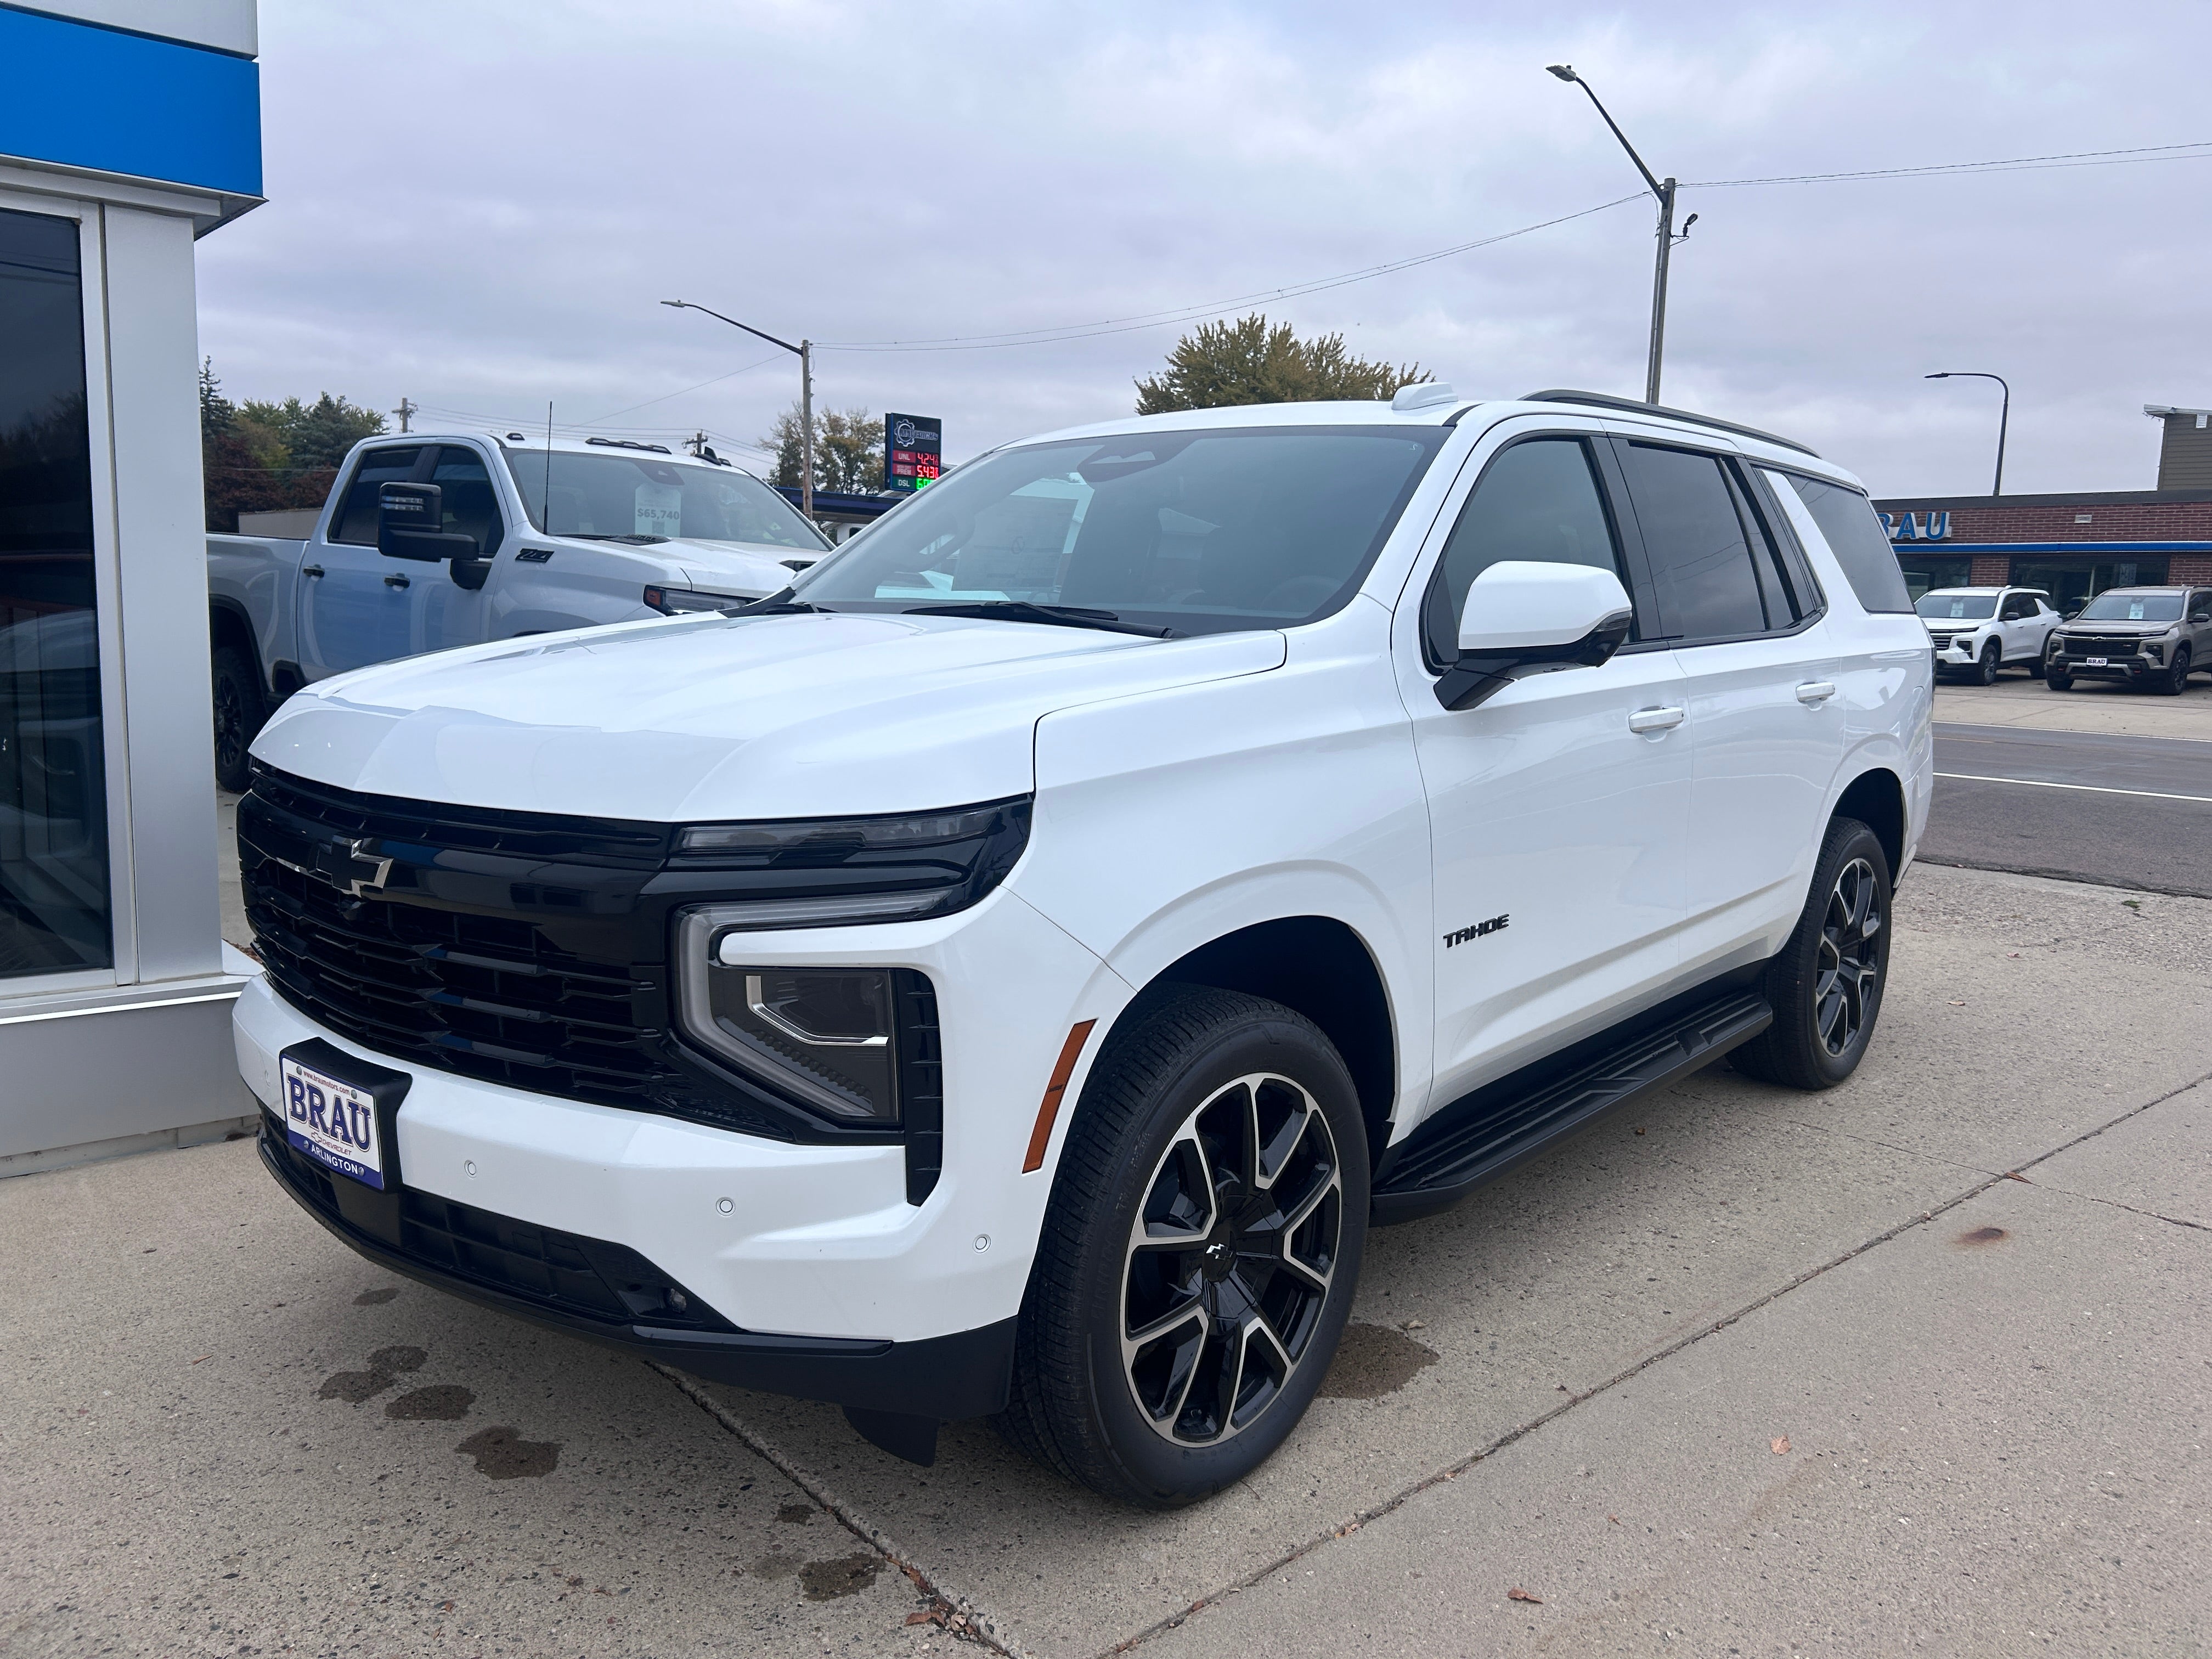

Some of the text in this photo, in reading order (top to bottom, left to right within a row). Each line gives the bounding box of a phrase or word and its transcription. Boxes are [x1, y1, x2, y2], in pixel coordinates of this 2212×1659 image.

[637, 507, 680, 520] $65,740
[1443, 913, 1510, 949] TAHOE
[286, 1073, 371, 1152] BRAU
[311, 1144, 359, 1175] ARLINGTON
[322, 1139, 352, 1156] CHEVROLET
